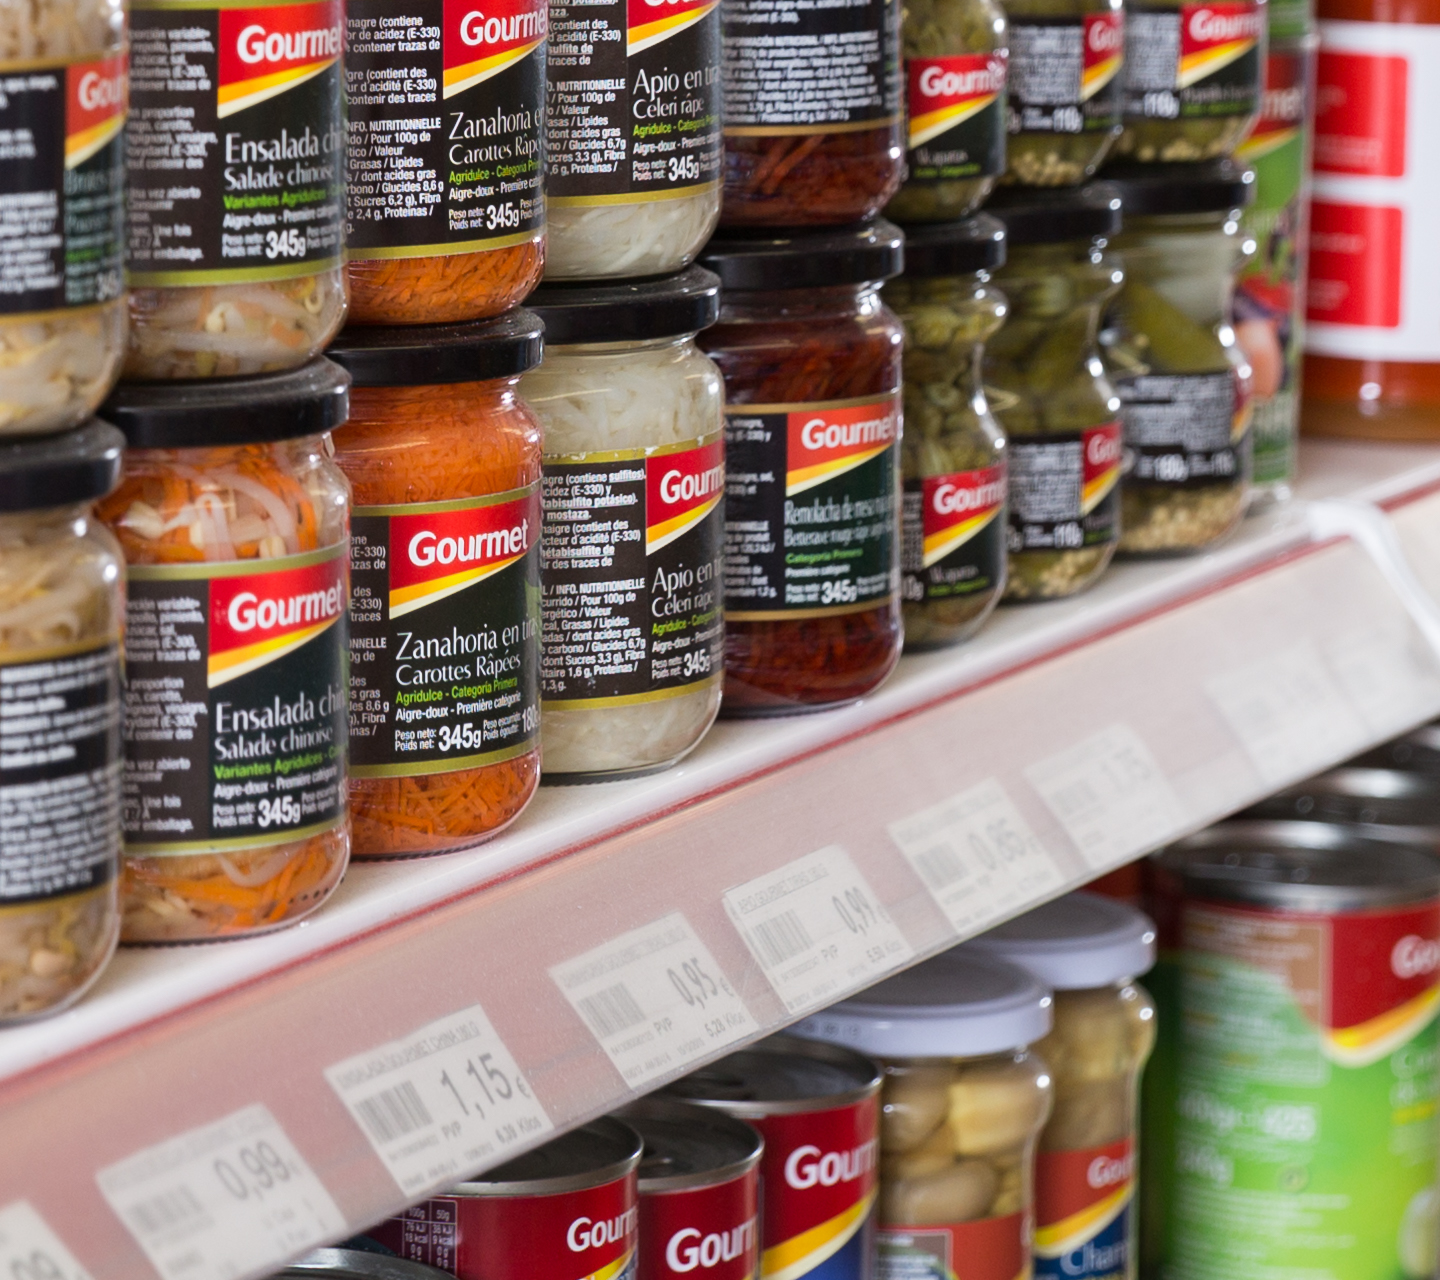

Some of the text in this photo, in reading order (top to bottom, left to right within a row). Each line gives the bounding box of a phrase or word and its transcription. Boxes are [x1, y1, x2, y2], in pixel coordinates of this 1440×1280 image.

[353, 39, 440, 53] contener trazas de
[633, 67, 703, 100] Apio en
[633, 98, 678, 119] Celeri
[369, 118, 441, 132] NUTRITIONNELLE
[449, 104, 531, 140] Zanahoria
[225, 126, 319, 164] Ensalada
[449, 143, 512, 166] Carottes
[350, 157, 423, 169] Grasas Lipides
[668, 155, 699, 181] 345g
[224, 165, 284, 190] Salade
[449, 167, 489, 185] Agridulce
[223, 193, 279, 210] Variantes
[223, 213, 277, 230] Aigre-doux
[487, 202, 519, 230] 345g
[265, 229, 306, 258] 345g
[547, 510, 591, 520] mostaza.
[408, 517, 528, 567] Gourmet
[652, 563, 693, 598] Apio
[821, 579, 857, 604] 345g
[228, 578, 342, 632] Gourmet
[395, 623, 519, 661] Zanahoria en
[547, 641, 626, 654] carbono Glucides
[396, 649, 521, 686] Carottes Râpées
[684, 649, 710, 677] 345g
[396, 676, 518, 707] Agridulce Categoría Primera
[216, 691, 314, 733] Ensalada
[396, 707, 448, 724] Aigre-doux
[457, 699, 493, 717] Première
[215, 731, 277, 760] Salade
[395, 729, 416, 741] Peso
[395, 739, 418, 752] Poids
[439, 723, 481, 752] 345g
[213, 762, 272, 780] Variantes
[257, 796, 301, 827] 345g
[667, 958, 719, 1010] 0,95
[654, 1019, 673, 1036] PVP
[441, 1053, 513, 1120] 1,15
[441, 1116, 542, 1140] PVP Kilos
[436, 1208, 451, 1221] 50g
